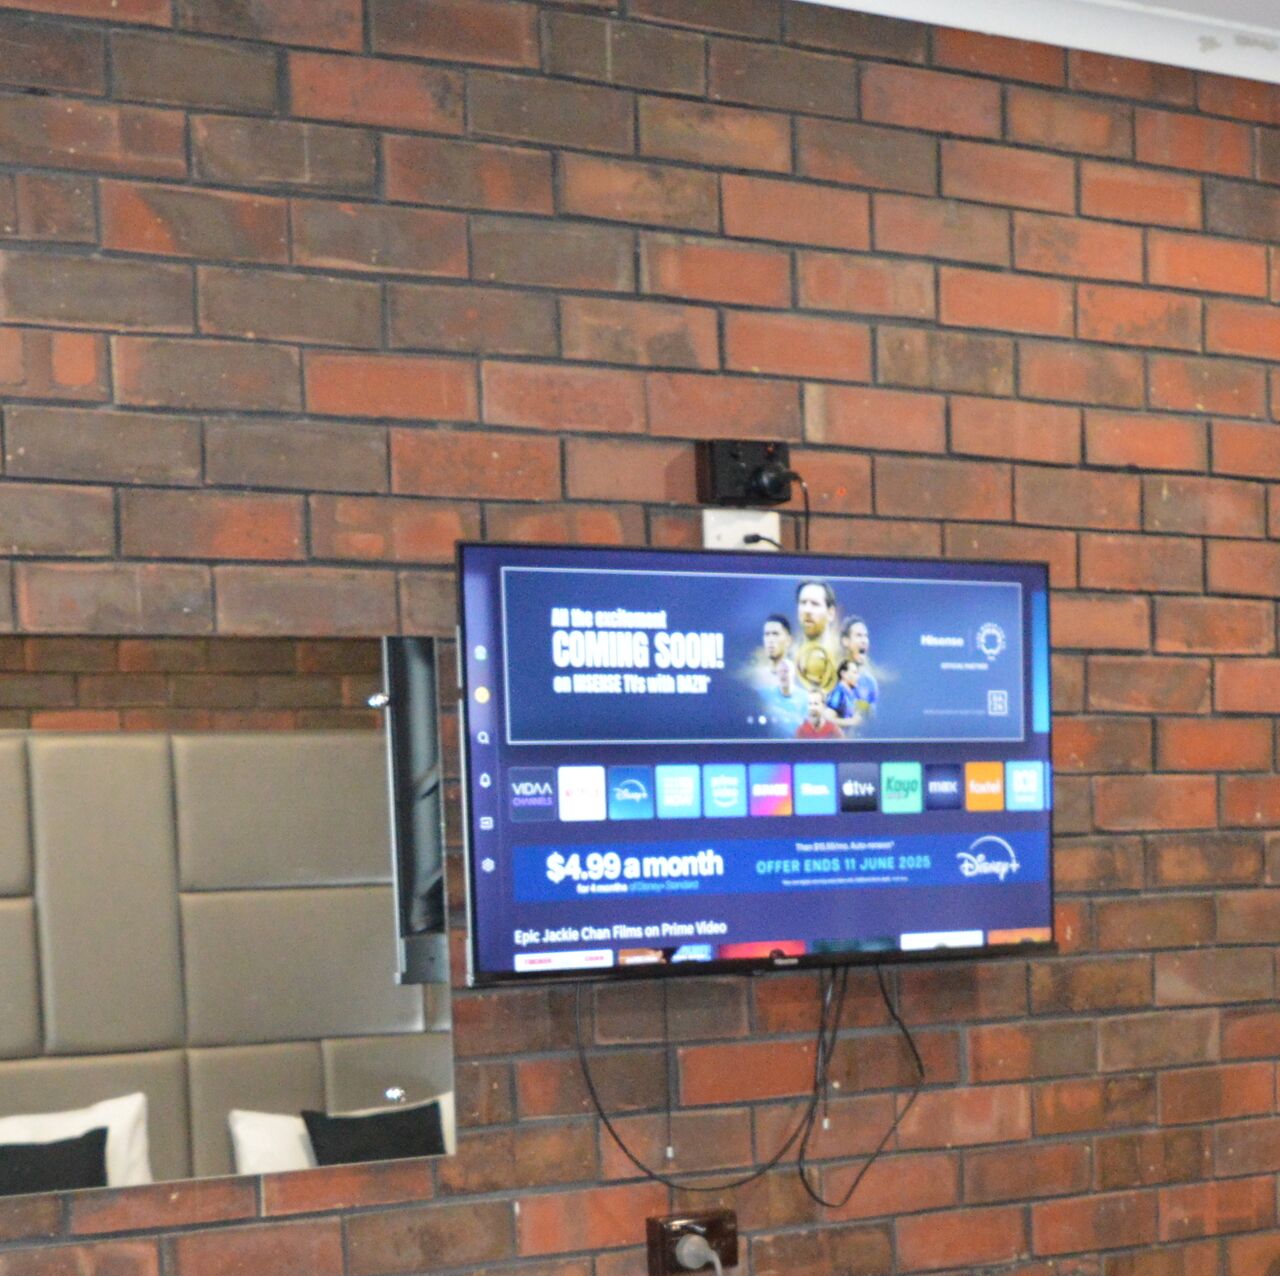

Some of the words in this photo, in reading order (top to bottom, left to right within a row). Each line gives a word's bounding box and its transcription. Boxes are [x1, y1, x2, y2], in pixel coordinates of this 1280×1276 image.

[571, 609, 593, 627] the
[595, 608, 667, 628] excitement
[553, 630, 649, 667] COMING
[654, 632, 724, 668] SOON!
[921, 634, 964, 647] Hisense
[553, 676, 571, 692] on
[647, 673, 675, 692] with
[512, 783, 553, 795] VIDAA
[885, 776, 918, 799] Kayo
[928, 781, 957, 793] max
[512, 796, 553, 806] CHANNELS
[546, 851, 621, 883] $4.99
[624, 857, 640, 878] a
[643, 849, 723, 878] month
[756, 859, 800, 874] OFFER
[804, 858, 840, 873] ENDS
[845, 858, 856, 871] 11
[859, 856, 895, 871] JUNE
[898, 855, 931, 869] 2025
[956, 841, 1020, 881] Disney+
[515, 930, 540, 945] Epic
[543, 928, 579, 942] Jackie
[581, 926, 610, 940] Chan
[613, 924, 642, 939] Films
[645, 926, 660, 937] on
[662, 922, 694, 936] Prime
[695, 921, 727, 935] Video
